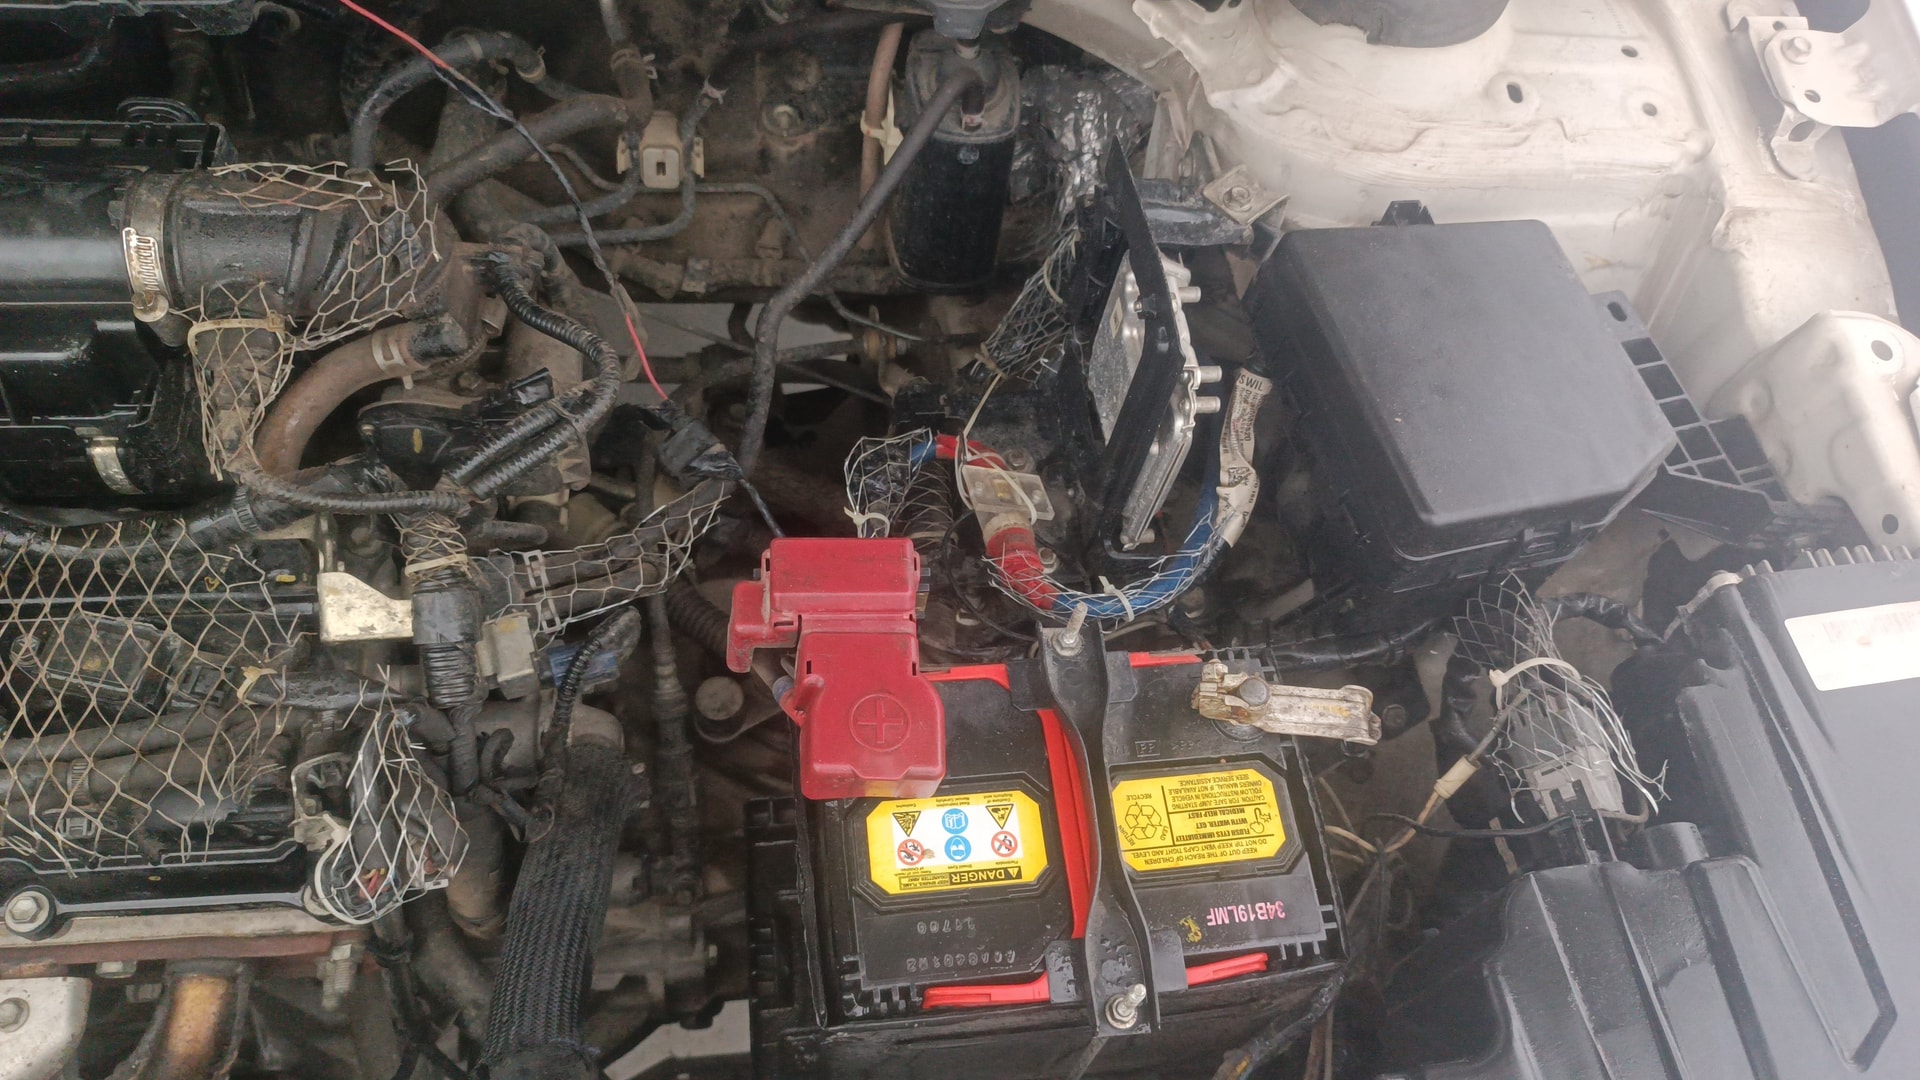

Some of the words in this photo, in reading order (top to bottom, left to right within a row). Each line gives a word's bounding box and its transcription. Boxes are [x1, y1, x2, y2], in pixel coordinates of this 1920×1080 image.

[1212, 776, 1234, 784] SERVICE
[1168, 787, 1196, 795] AVAILABLE
[1201, 790, 1239, 799] INSTRUCTIONS
[1240, 788, 1262, 796] FOLLOW
[1126, 793, 1152, 801] RECYCLE
[1172, 802, 1197, 810] STARTING
[1218, 808, 1245, 816] MEDICAL
[1160, 826, 1168, 842] LEAD
[1231, 828, 1250, 836] FLUSH
[1176, 832, 1215, 842] IMMEDIATELY
[1144, 857, 1174, 865] CHILDREN
[951, 869, 1005, 883] DANGER
[1206, 901, 1285, 926] 34B19LMF
